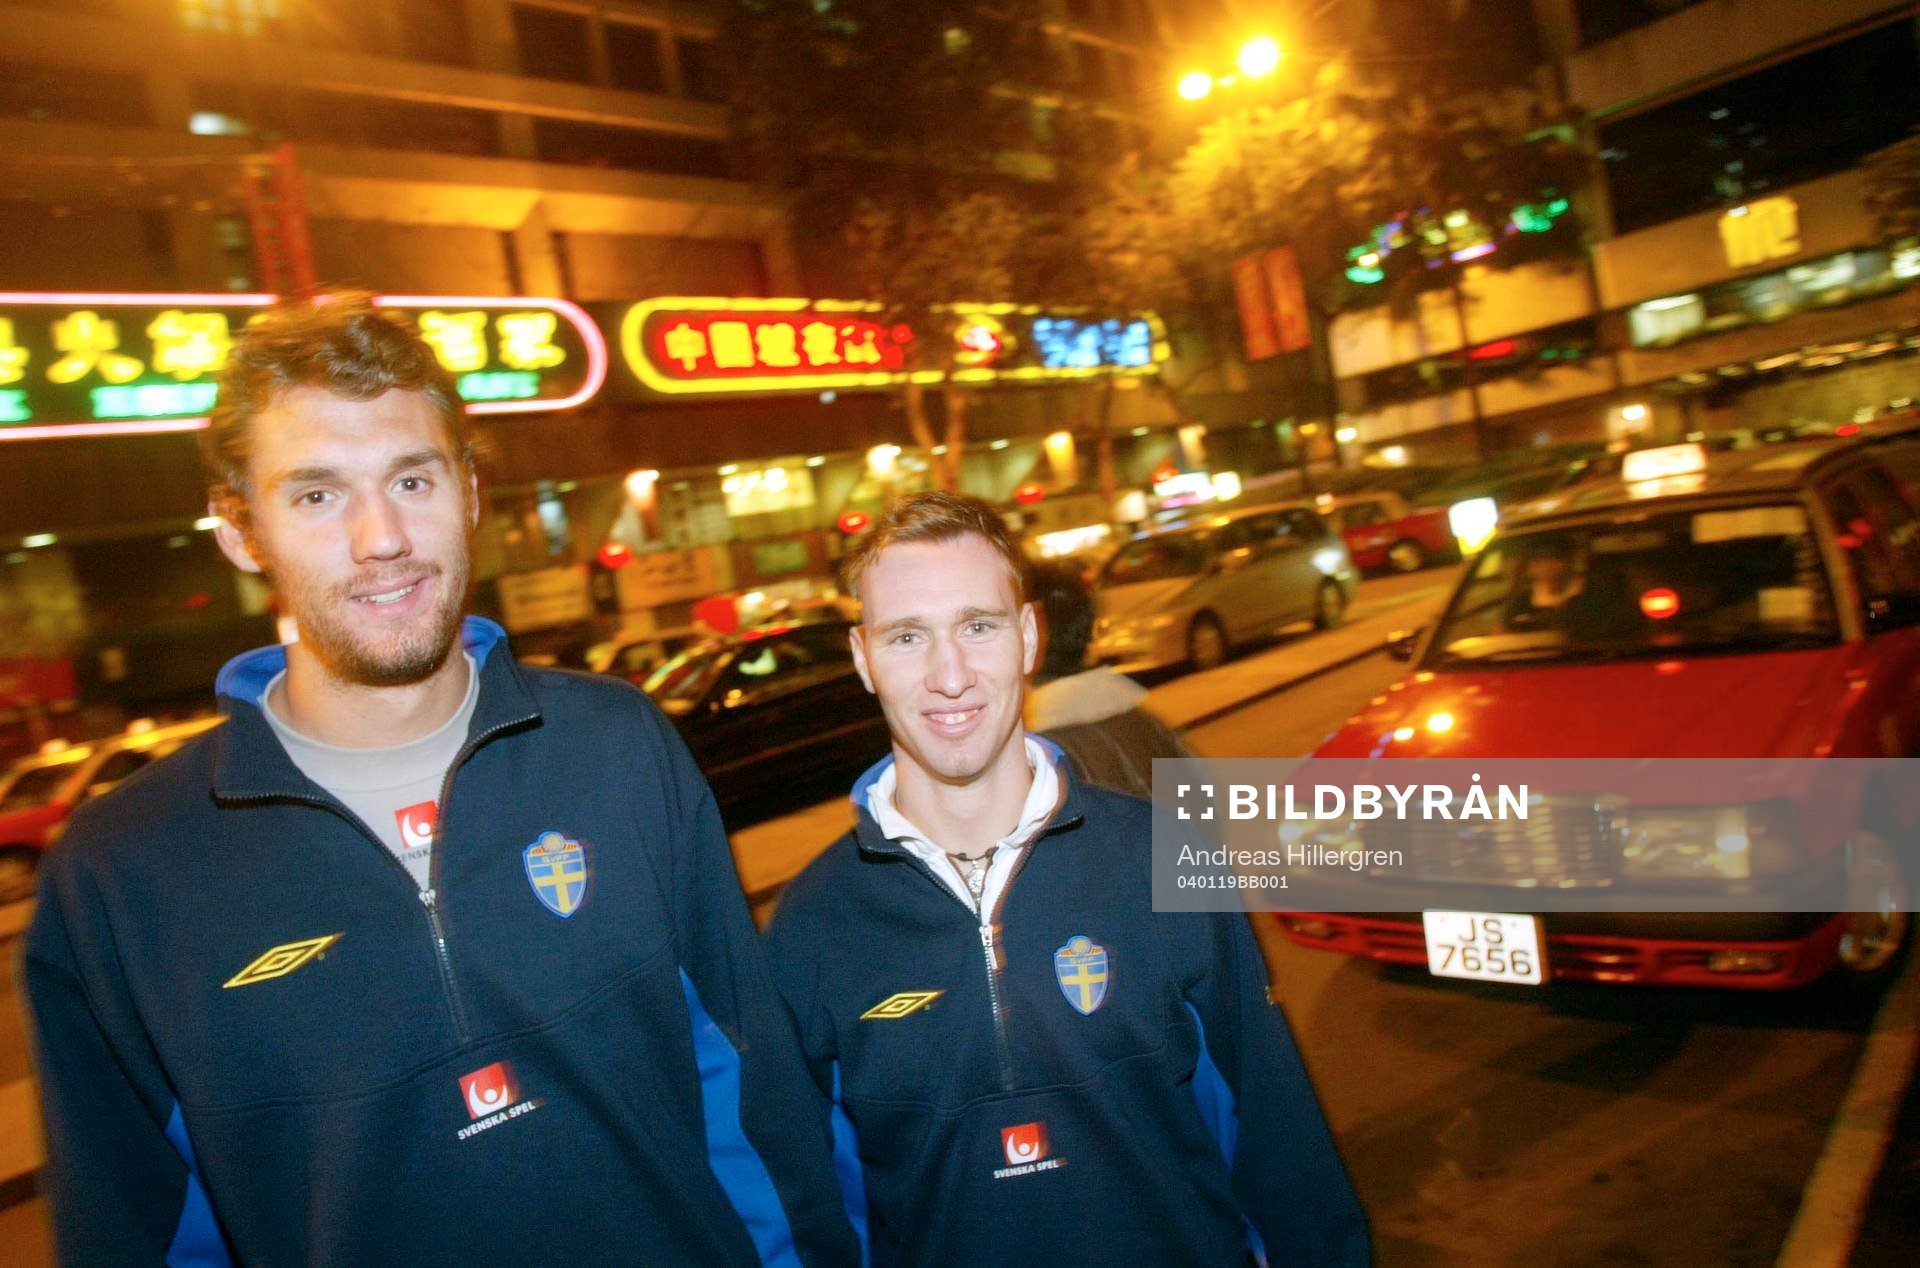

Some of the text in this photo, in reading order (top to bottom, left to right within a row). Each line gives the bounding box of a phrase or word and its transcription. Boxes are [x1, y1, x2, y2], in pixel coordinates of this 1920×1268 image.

[1458, 917, 1504, 945] JS
[1437, 944, 1532, 976] 7656
[457, 1101, 537, 1140] SVENSKA SPEL
[993, 1160, 1059, 1179] SVENSKA SPEL
